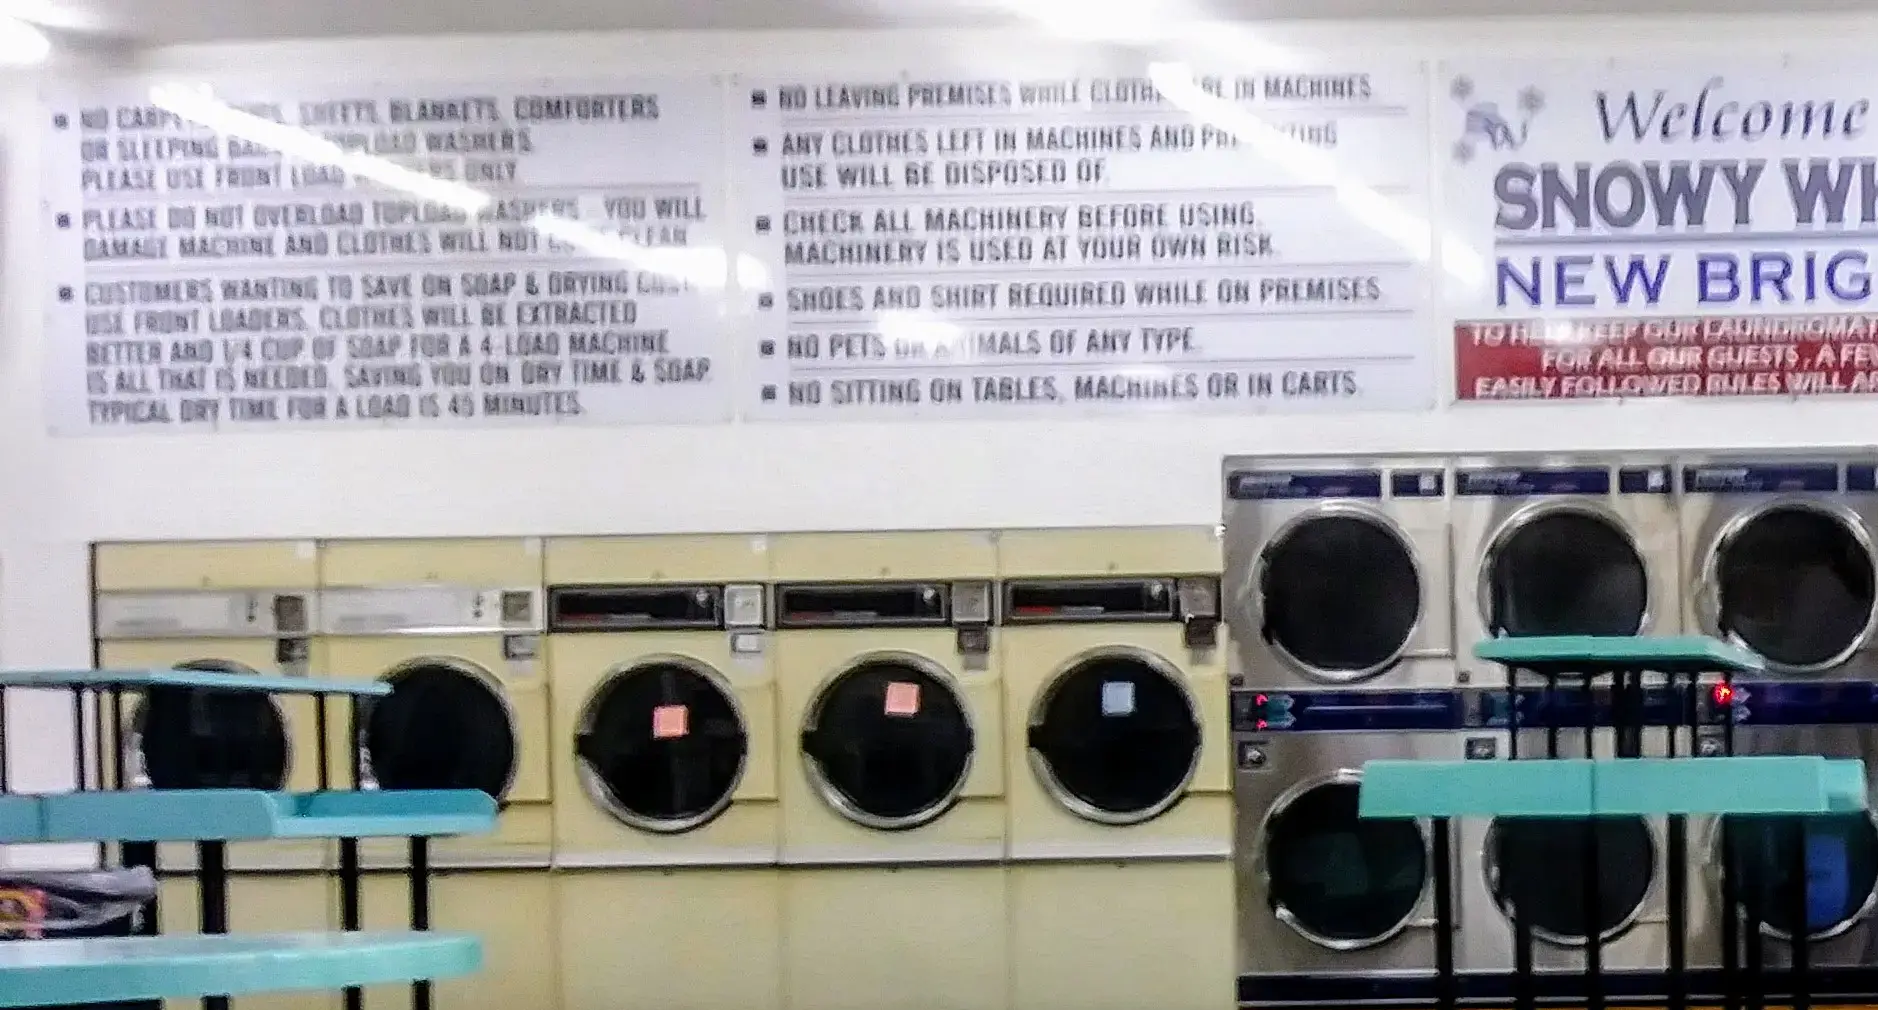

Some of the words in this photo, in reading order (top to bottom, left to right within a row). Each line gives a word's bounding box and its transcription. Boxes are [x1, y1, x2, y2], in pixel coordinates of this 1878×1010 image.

[1595, 76, 1870, 143] Welcome
[782, 130, 823, 155] ANY
[832, 128, 928, 154] CLOTHES
[936, 127, 985, 153] LEFT
[994, 126, 1016, 152] IN
[1026, 124, 1141, 152] MACHINES
[1149, 123, 1195, 151] AND
[782, 163, 826, 188] USE
[837, 162, 894, 188] WILL
[905, 161, 932, 187] BE
[944, 158, 1066, 185] DISPOSED
[1494, 160, 1768, 230] SNOWY
[784, 209, 863, 235] CHECK
[874, 207, 914, 232] ALL
[925, 205, 1068, 231] MACHINERY
[1078, 203, 1168, 229] BEFORE
[785, 238, 926, 264] MACHINERY
[936, 237, 961, 263] IS
[969, 236, 1033, 263] USED
[1043, 236, 1068, 262] AT
[1077, 234, 1141, 261] YOUR
[1151, 233, 1207, 259] OWN
[787, 286, 863, 311] SHOES
[873, 285, 921, 310] AND
[931, 283, 999, 309] SHIRT
[1008, 281, 1126, 307] REQUIRED
[1134, 279, 1207, 306] WHILE
[1217, 278, 1250, 304] ON
[1496, 254, 1672, 306] NEW
[788, 333, 820, 358] NO
[829, 332, 886, 358] PETS
[1050, 329, 1077, 354] OF
[1087, 328, 1131, 353] ANY
[1541, 348, 1596, 373] FOR
[1599, 347, 1645, 373] ALL
[1647, 346, 1704, 373] OUR
[1814, 343, 1837, 369] A
[789, 380, 821, 405] NO
[831, 377, 921, 404] SITTING
[930, 377, 962, 402] ON
[1075, 373, 1198, 400] MACHINES
[1207, 371, 1239, 398] OR
[1248, 371, 1273, 397] IN
[1475, 374, 1557, 399] EASILY
[1785, 371, 1848, 395] WILL
